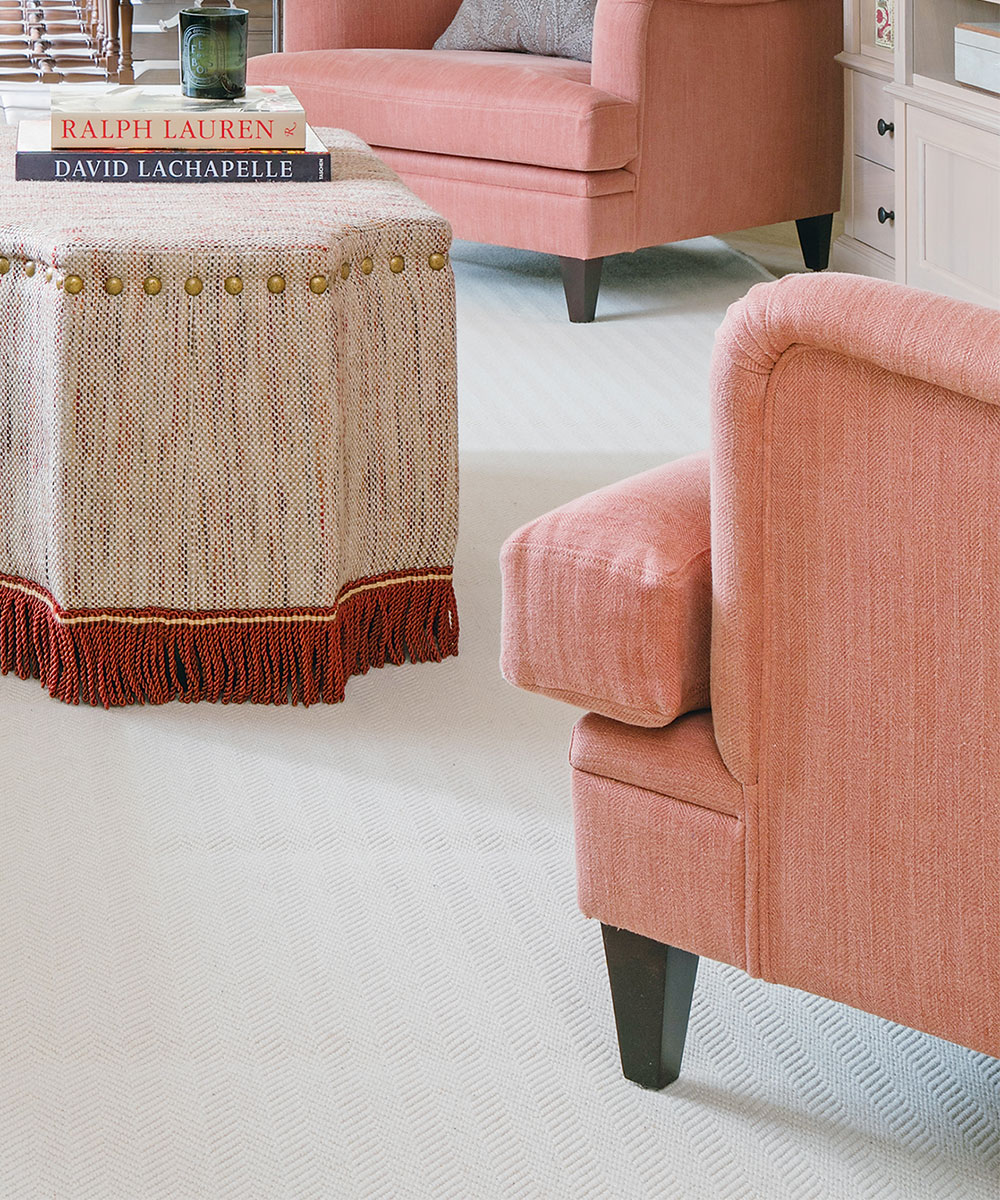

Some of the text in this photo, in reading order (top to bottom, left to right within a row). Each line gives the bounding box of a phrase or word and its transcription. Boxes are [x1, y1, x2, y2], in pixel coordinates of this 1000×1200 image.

[61, 119, 275, 140] RALPH LAUREN
[54, 160, 294, 179] DAVID LACHAPELLE
